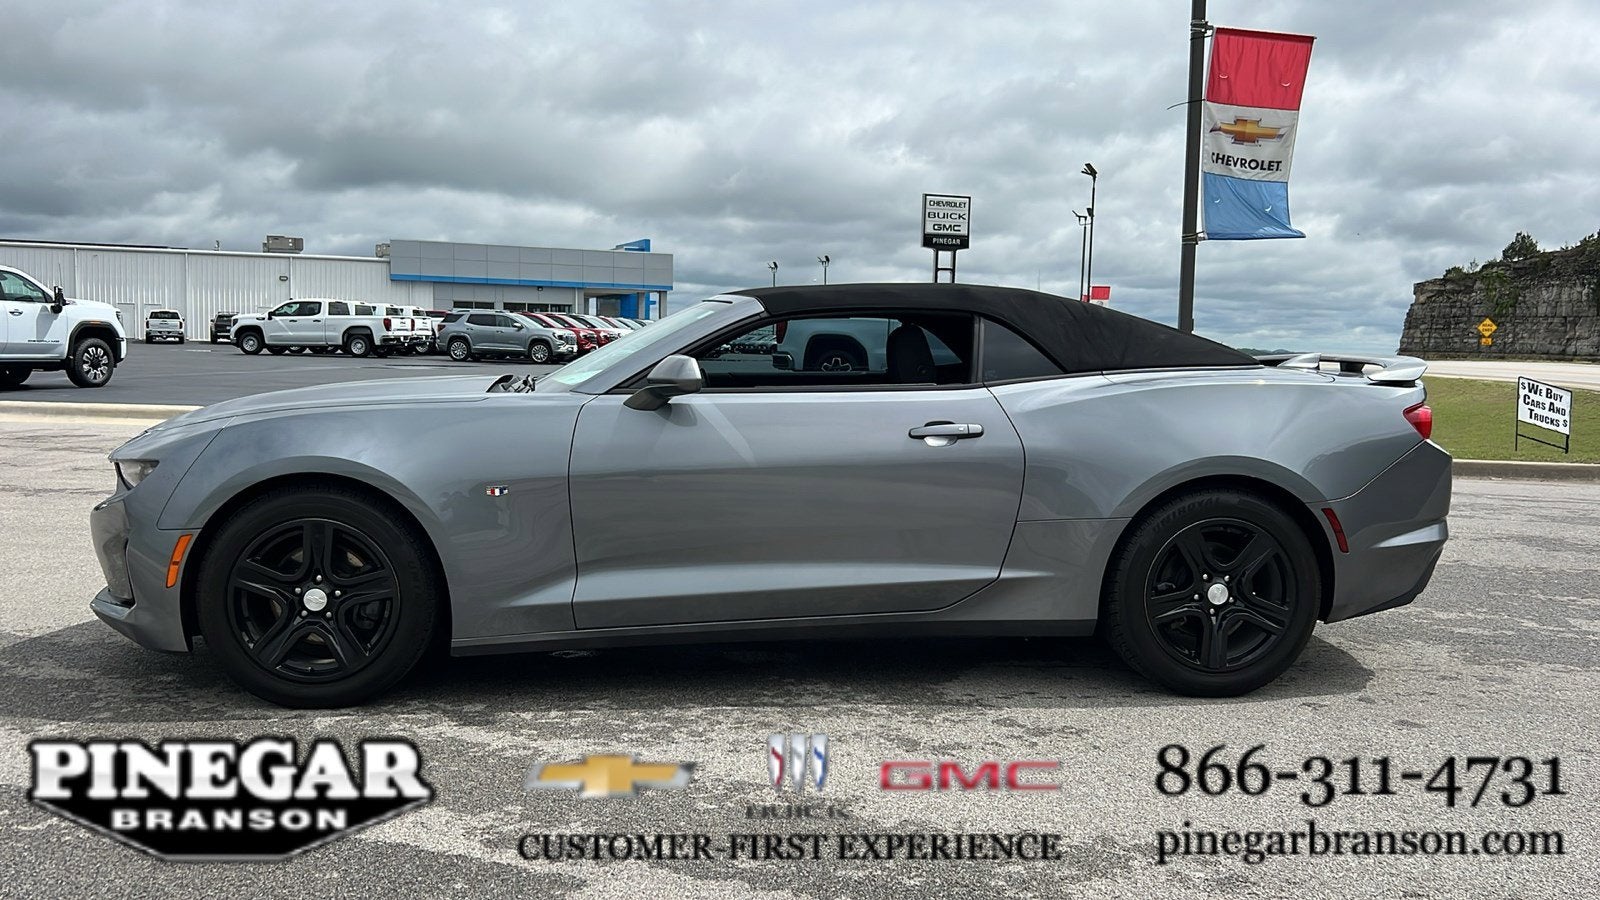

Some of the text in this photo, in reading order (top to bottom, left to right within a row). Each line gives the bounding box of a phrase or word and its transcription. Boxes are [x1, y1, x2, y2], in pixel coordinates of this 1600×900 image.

[929, 200, 966, 208] CHEVROLET
[928, 212, 966, 220] BUICK
[933, 224, 961, 232] GMC
